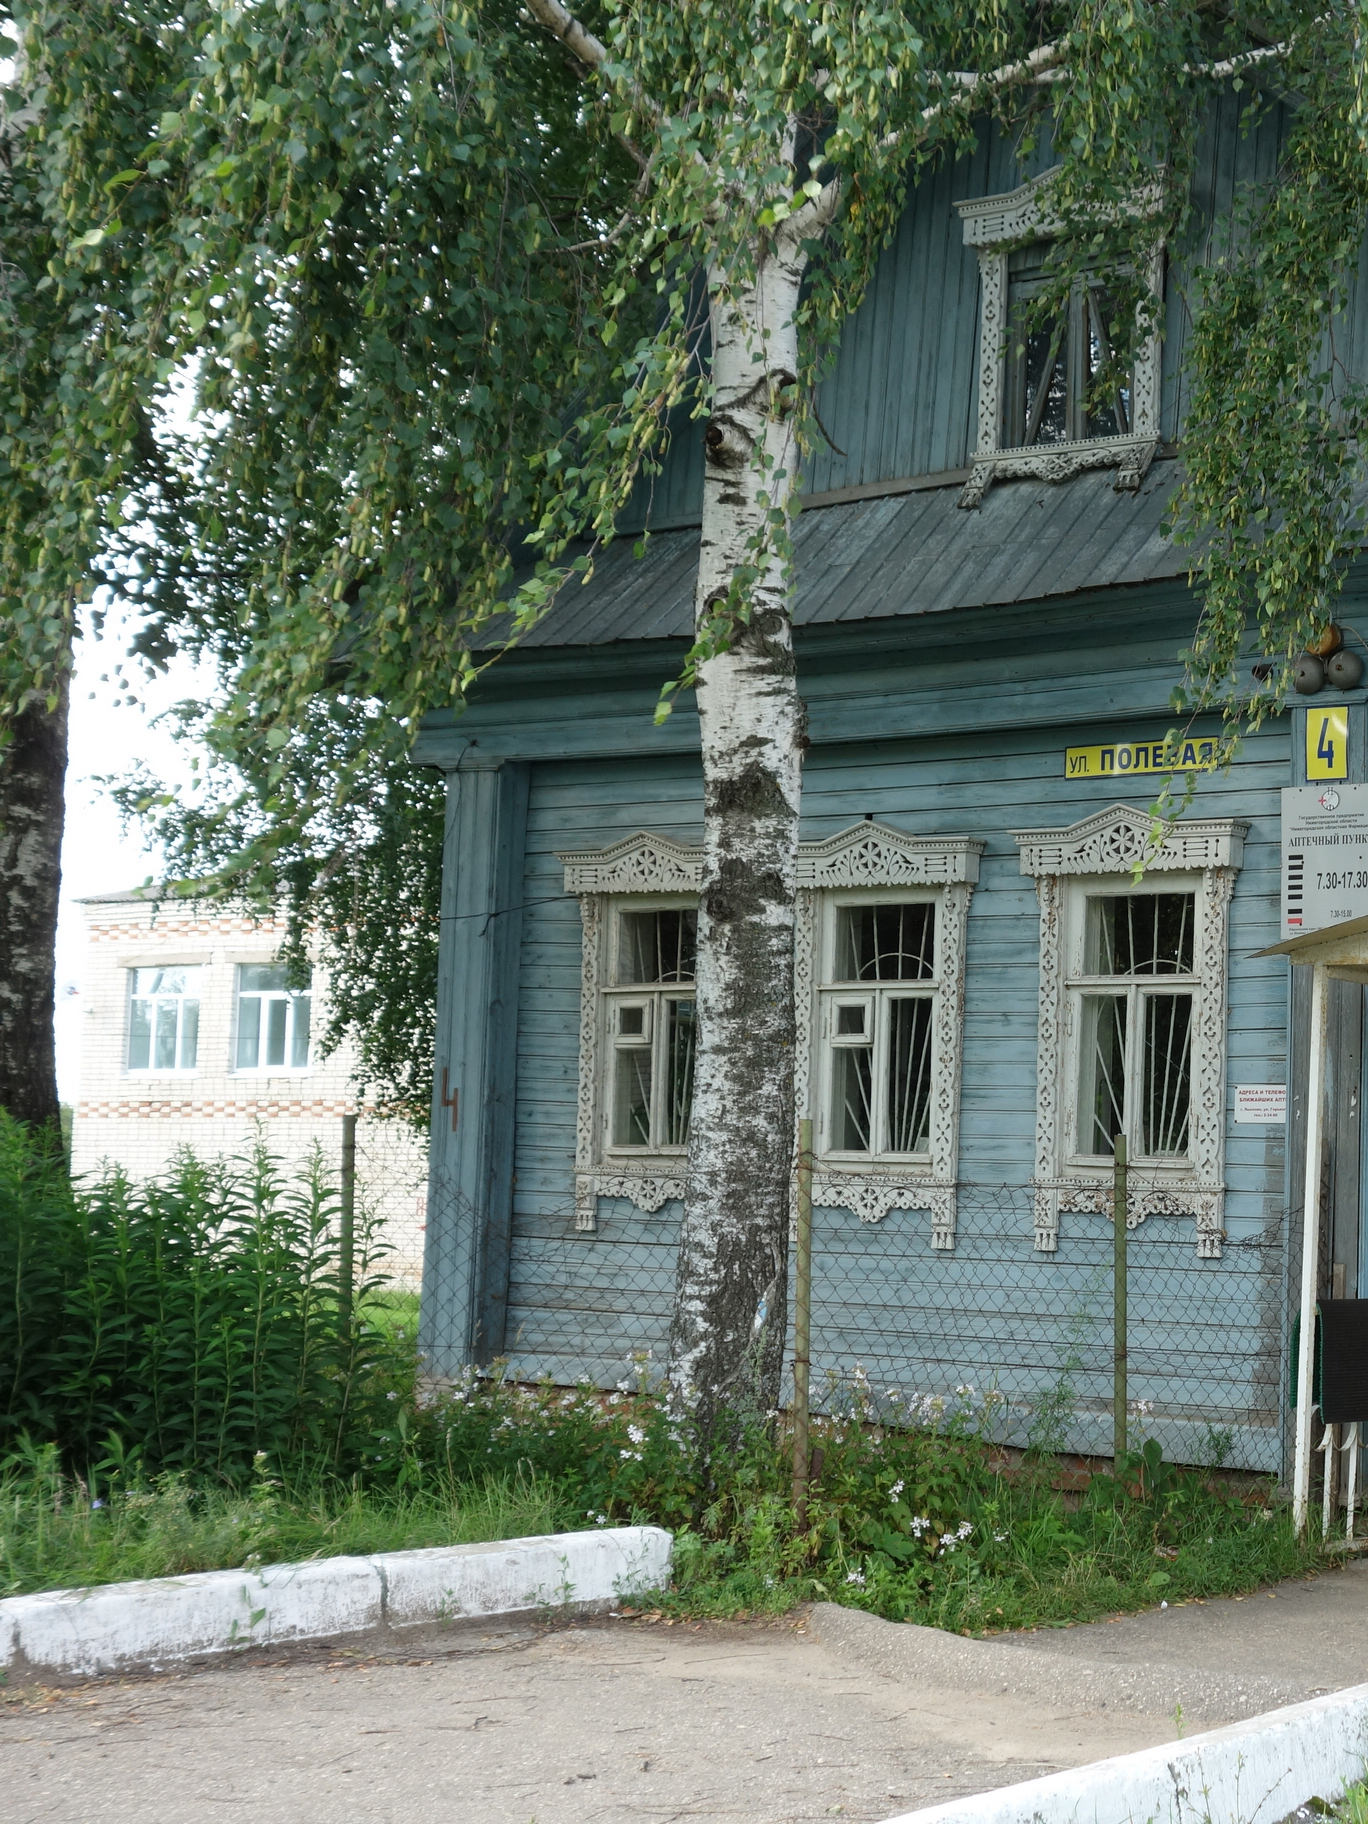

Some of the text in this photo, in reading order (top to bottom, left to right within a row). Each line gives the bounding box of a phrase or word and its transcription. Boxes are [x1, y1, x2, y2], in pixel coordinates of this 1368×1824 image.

[1317, 717, 1334, 768] 4
[1288, 833, 1340, 847] АПТЕЧНЫЙ
[1316, 871, 1368, 890] 7.30-17.30
[441, 1067, 459, 1132] 4
